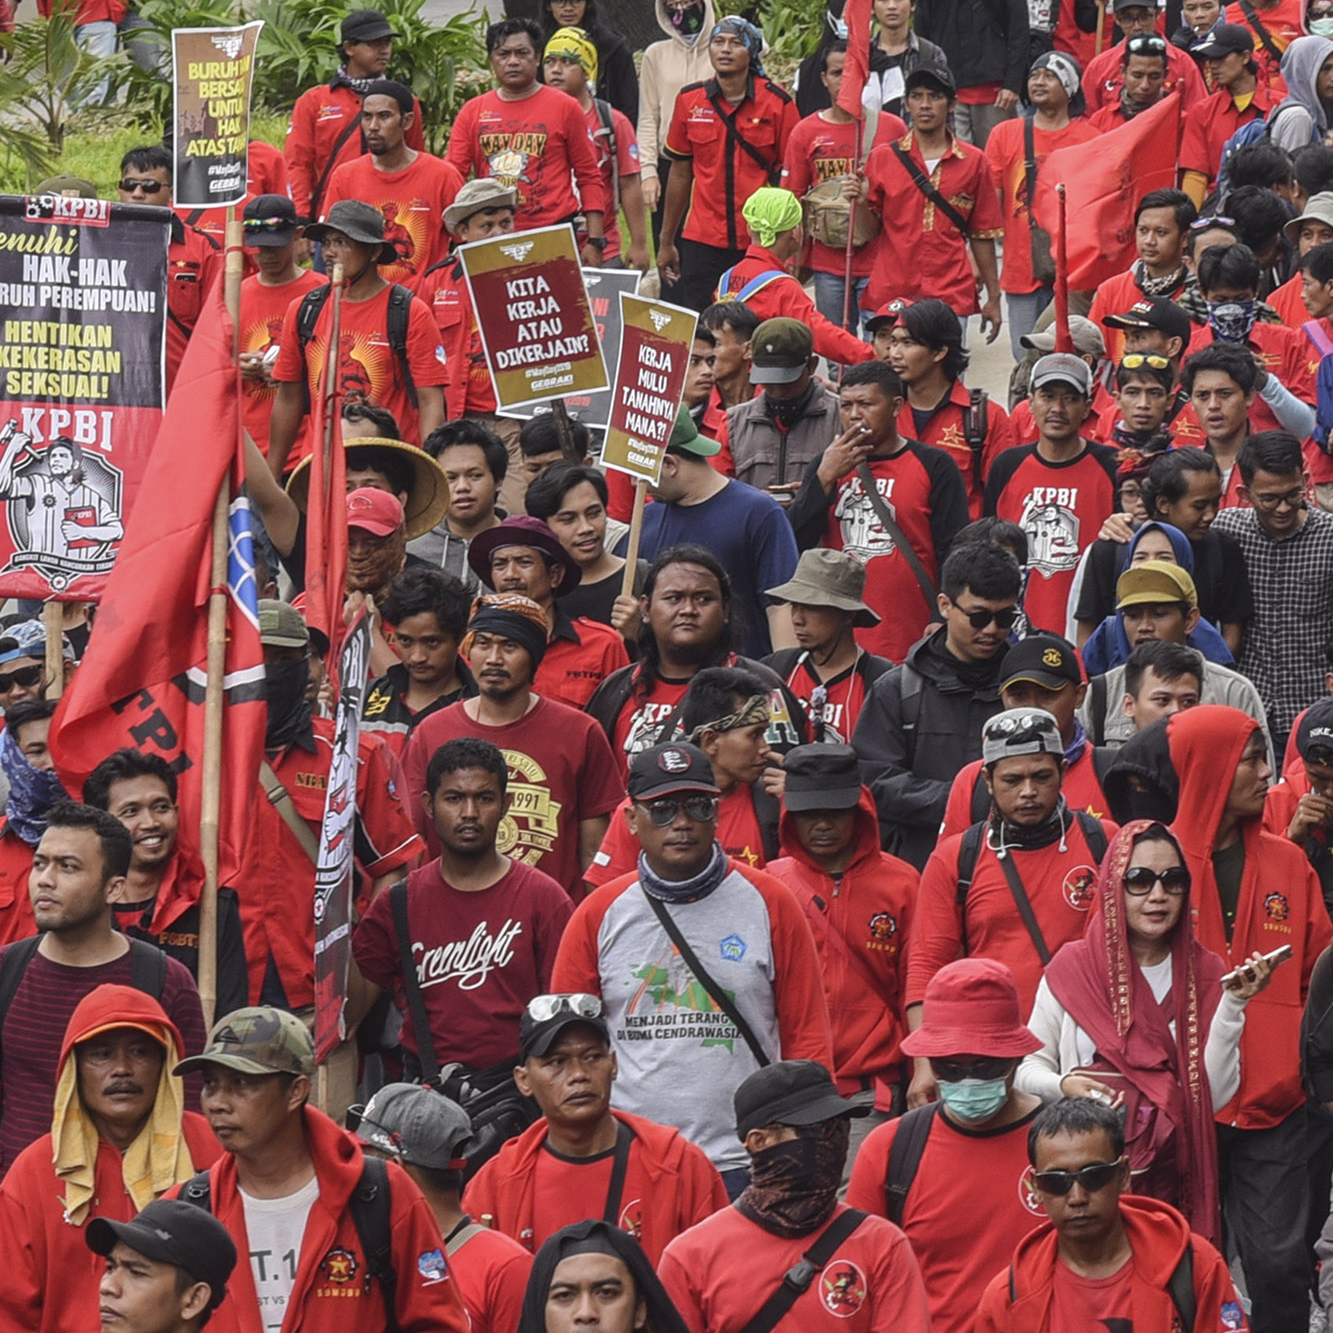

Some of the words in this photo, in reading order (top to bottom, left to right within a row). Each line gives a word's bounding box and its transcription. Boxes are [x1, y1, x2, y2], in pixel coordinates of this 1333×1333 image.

[188, 62, 238, 80] BURUH
[185, 140, 226, 157] ATAS
[480, 133, 513, 157] MAY
[513, 133, 548, 157] DAY
[53, 197, 107, 220] KPBI
[0, 225, 78, 255] enuhi
[23, 254, 127, 287] HAK-HAK
[0, 283, 35, 307] RUH
[40, 285, 156, 313] PEREMPUAN!
[506, 275, 551, 299] KITA
[506, 296, 561, 321] KERJA
[5, 321, 112, 348] HENTIKAN
[517, 317, 563, 343] ATAU
[0, 346, 120, 373] KEKERASAN
[495, 334, 590, 370] DIKERJAIN?
[638, 344, 672, 373] KERJA
[6, 371, 109, 398] SEKSUAL!
[637, 368, 668, 394] MULU
[622, 386, 675, 423] TANAHNYA
[21, 407, 114, 452] KPBI
[851, 477, 895, 498] KBI
[1033, 487, 1078, 510] KPBI
[625, 1013, 677, 1028] MENJADI
[679, 1012, 730, 1025] TERANG
[617, 1030, 628, 1041] DI
[629, 1029, 653, 1041] BUMI
